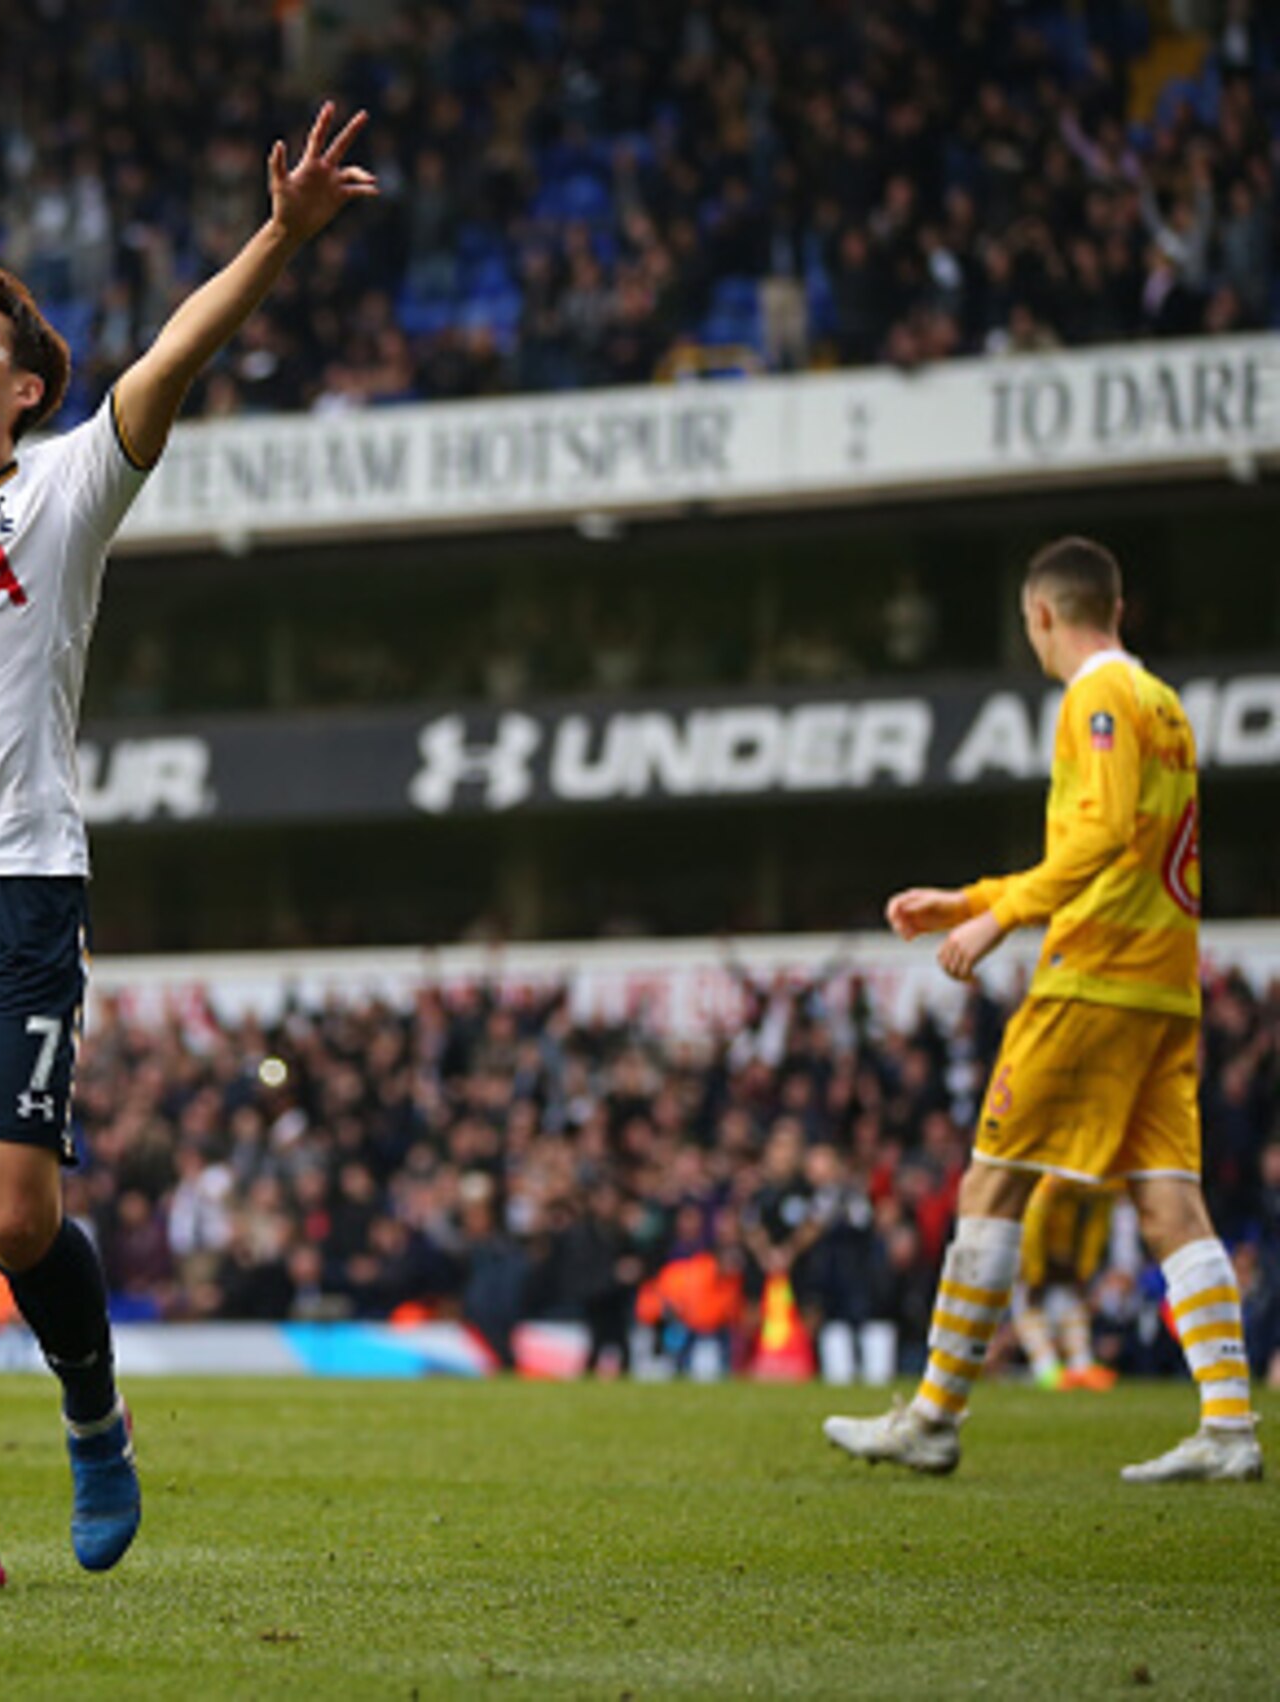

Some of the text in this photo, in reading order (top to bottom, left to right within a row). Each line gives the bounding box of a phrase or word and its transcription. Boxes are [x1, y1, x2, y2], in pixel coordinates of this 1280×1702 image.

[426, 405, 734, 494] HOTSPUR
[986, 366, 1076, 456] TO
[549, 700, 933, 798] UNDER
[26, 1015, 62, 1090] 7
[989, 1064, 1012, 1116] 6
